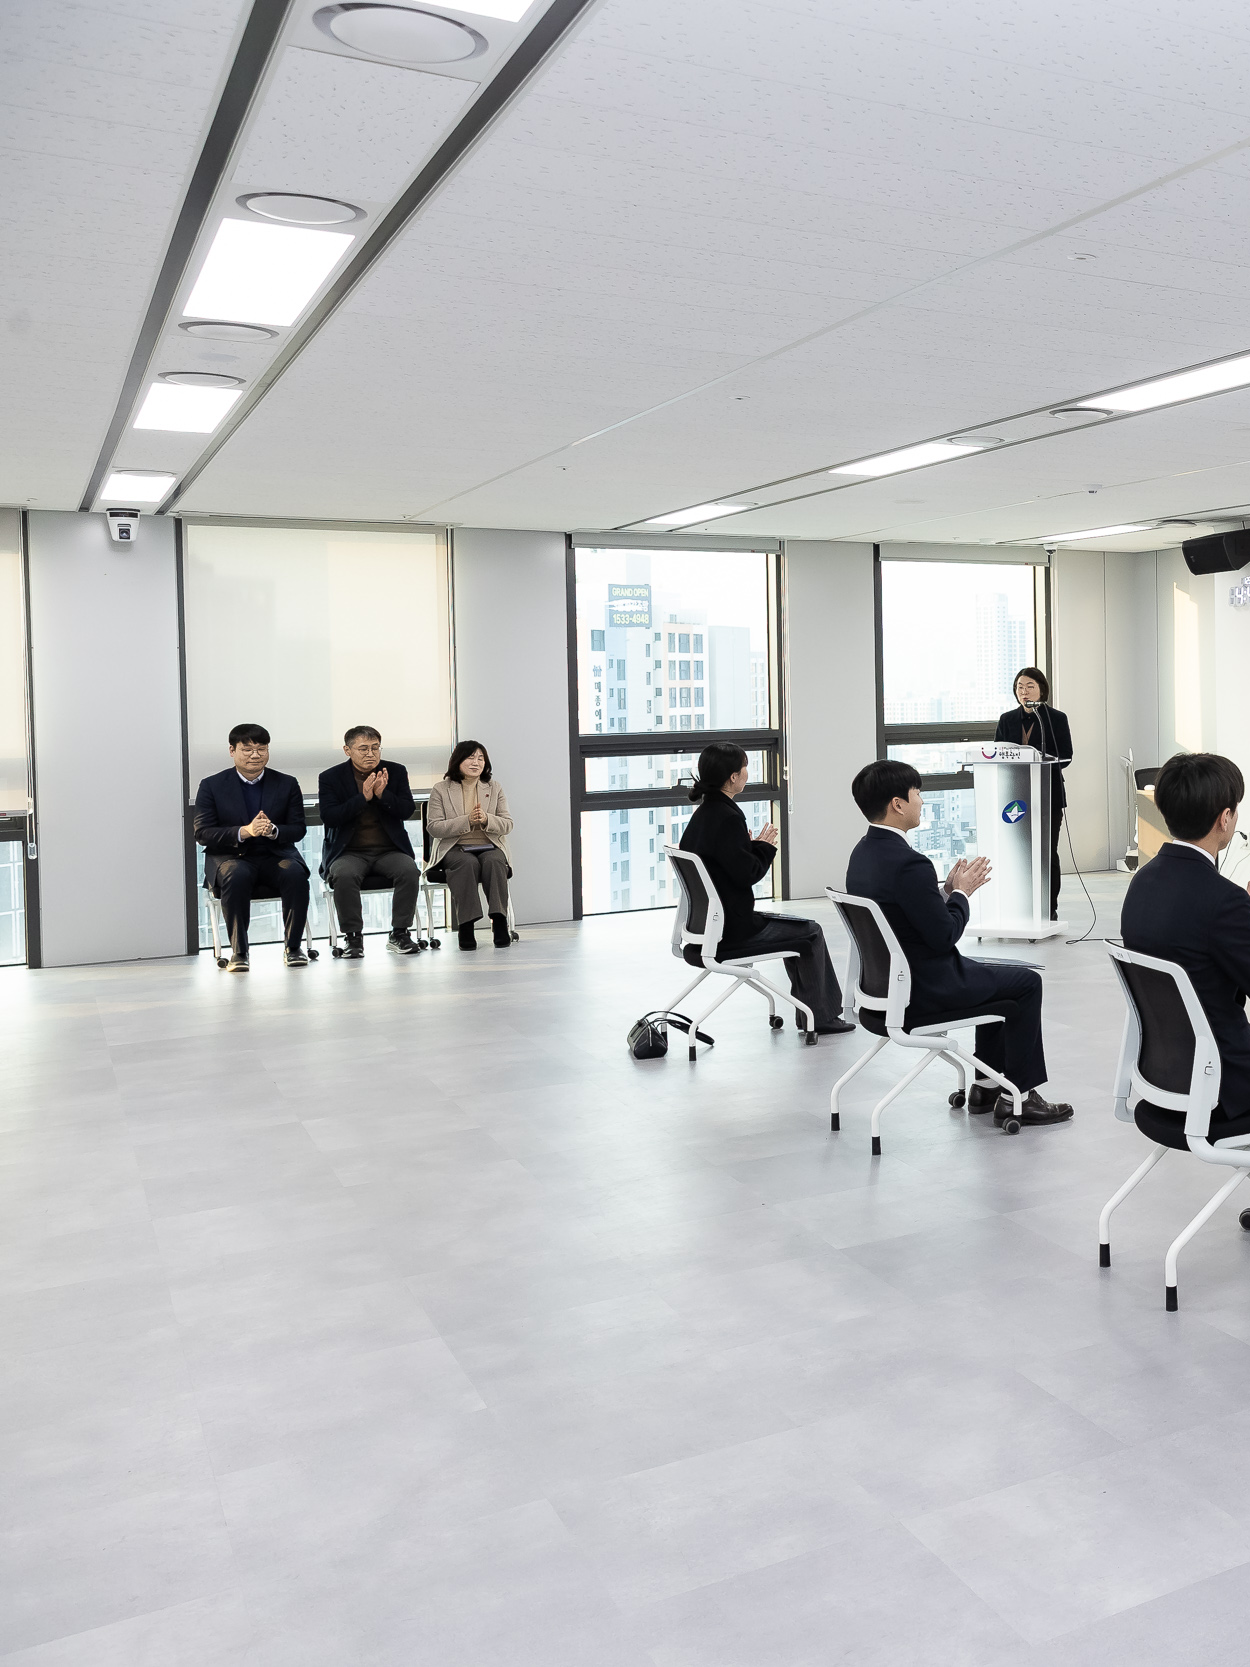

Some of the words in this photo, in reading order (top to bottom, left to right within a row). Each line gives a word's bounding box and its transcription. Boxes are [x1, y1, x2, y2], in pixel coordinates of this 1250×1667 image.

[612, 587, 633, 597] GRAND
[634, 588, 649, 597] OPEN
[613, 613, 649, 625] 1533-4948
